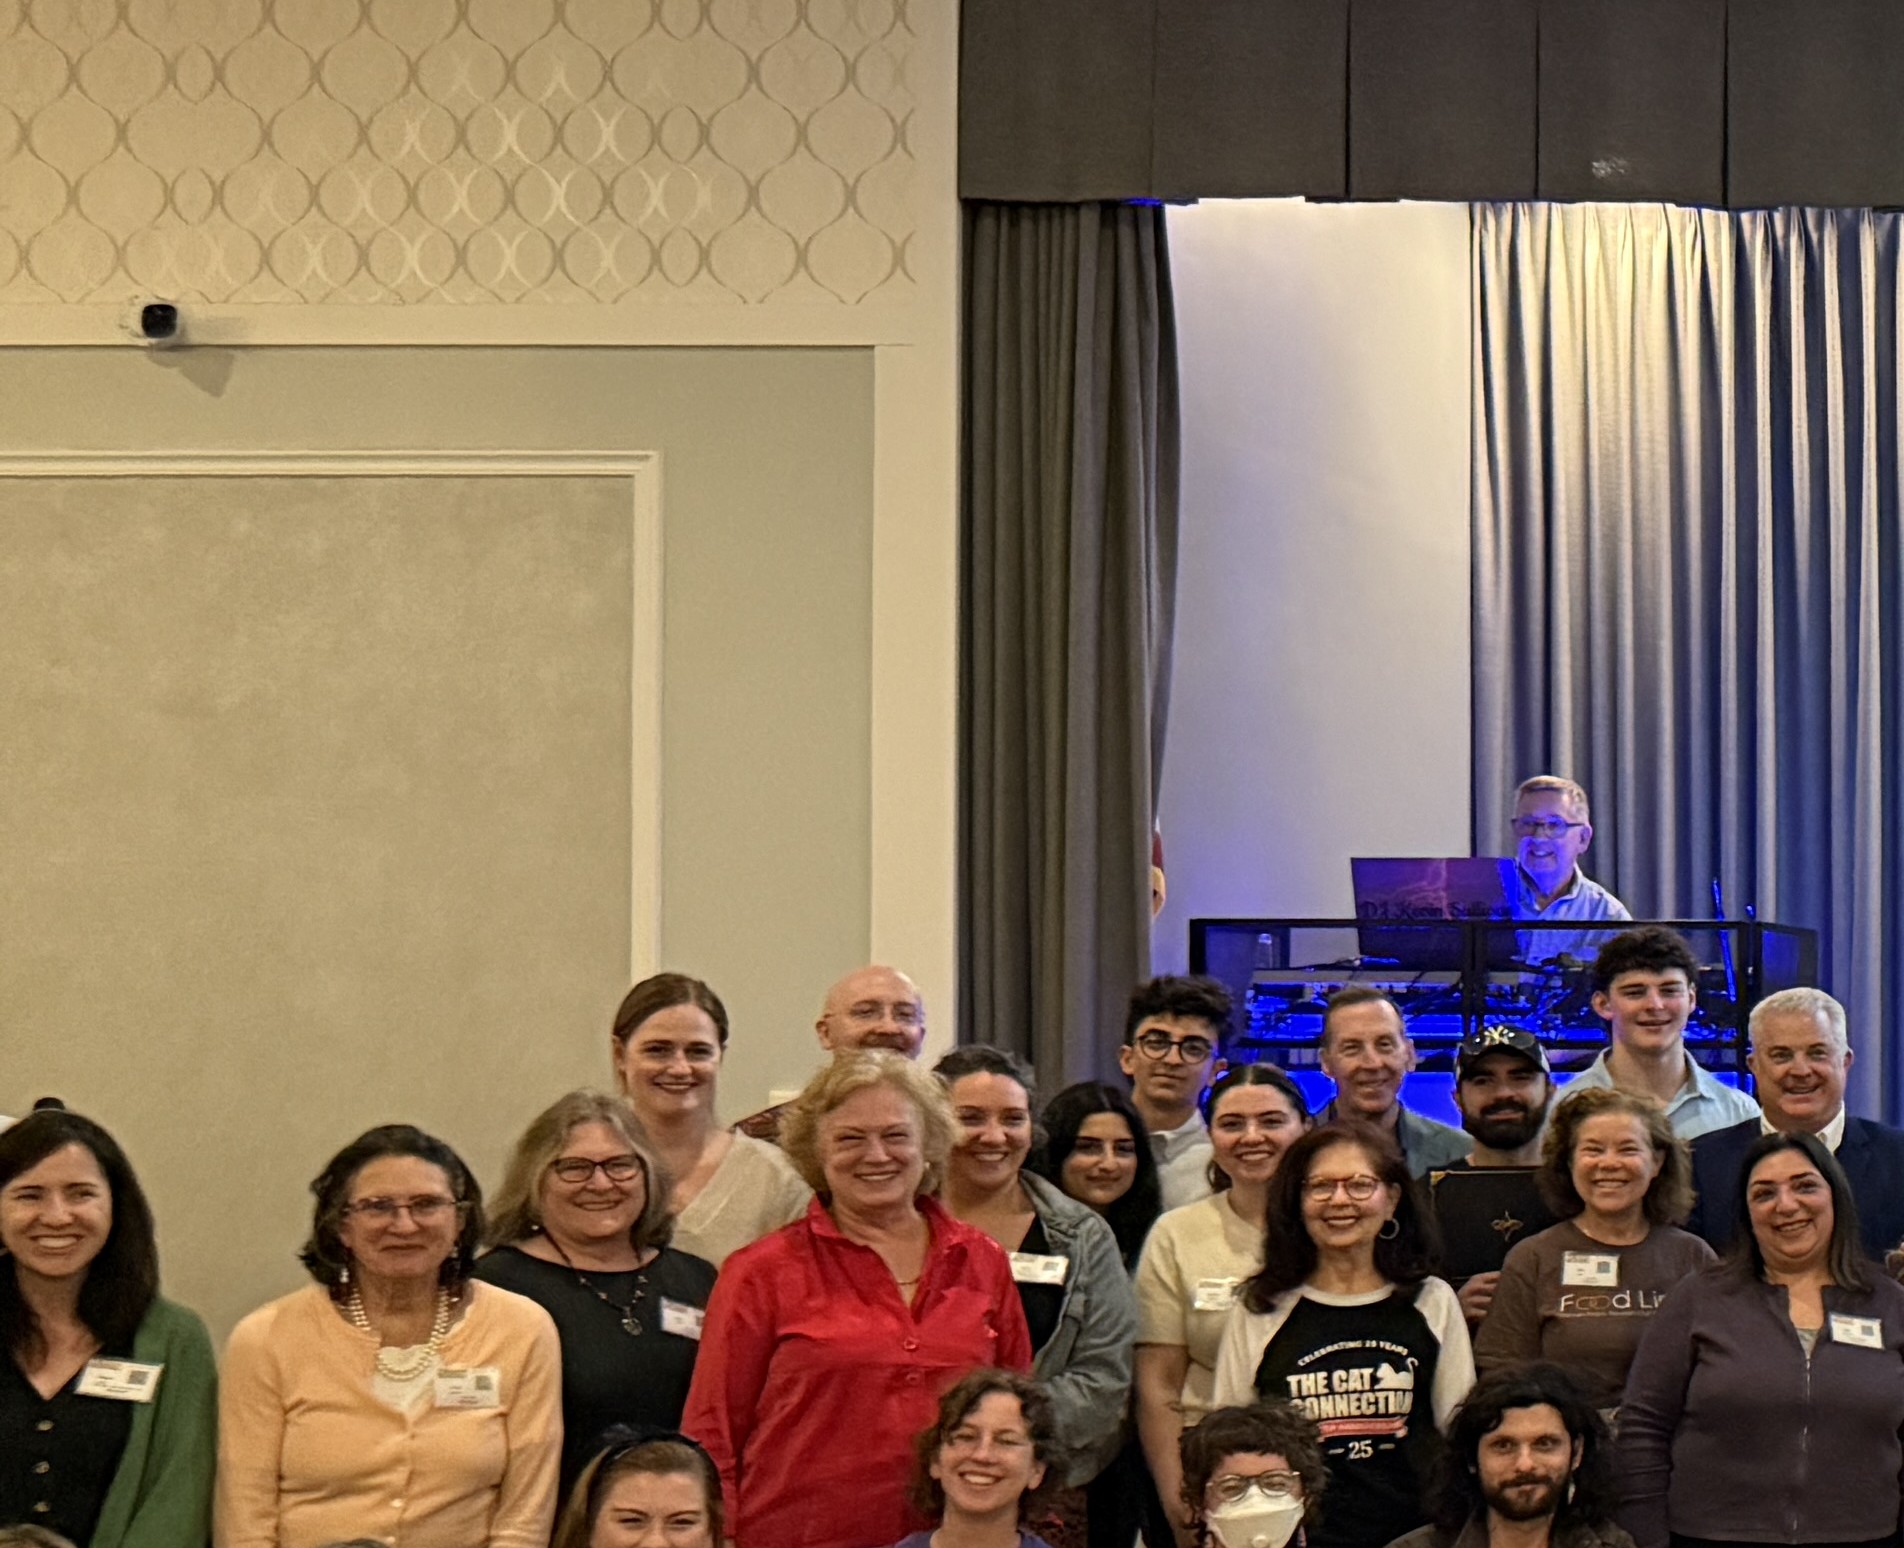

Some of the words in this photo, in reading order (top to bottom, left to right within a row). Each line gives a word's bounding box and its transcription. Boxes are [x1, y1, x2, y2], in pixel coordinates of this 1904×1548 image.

[1286, 1370, 1330, 1398] THE
[1332, 1367, 1375, 1392] CAT
[1348, 1440, 1374, 1460] 25
